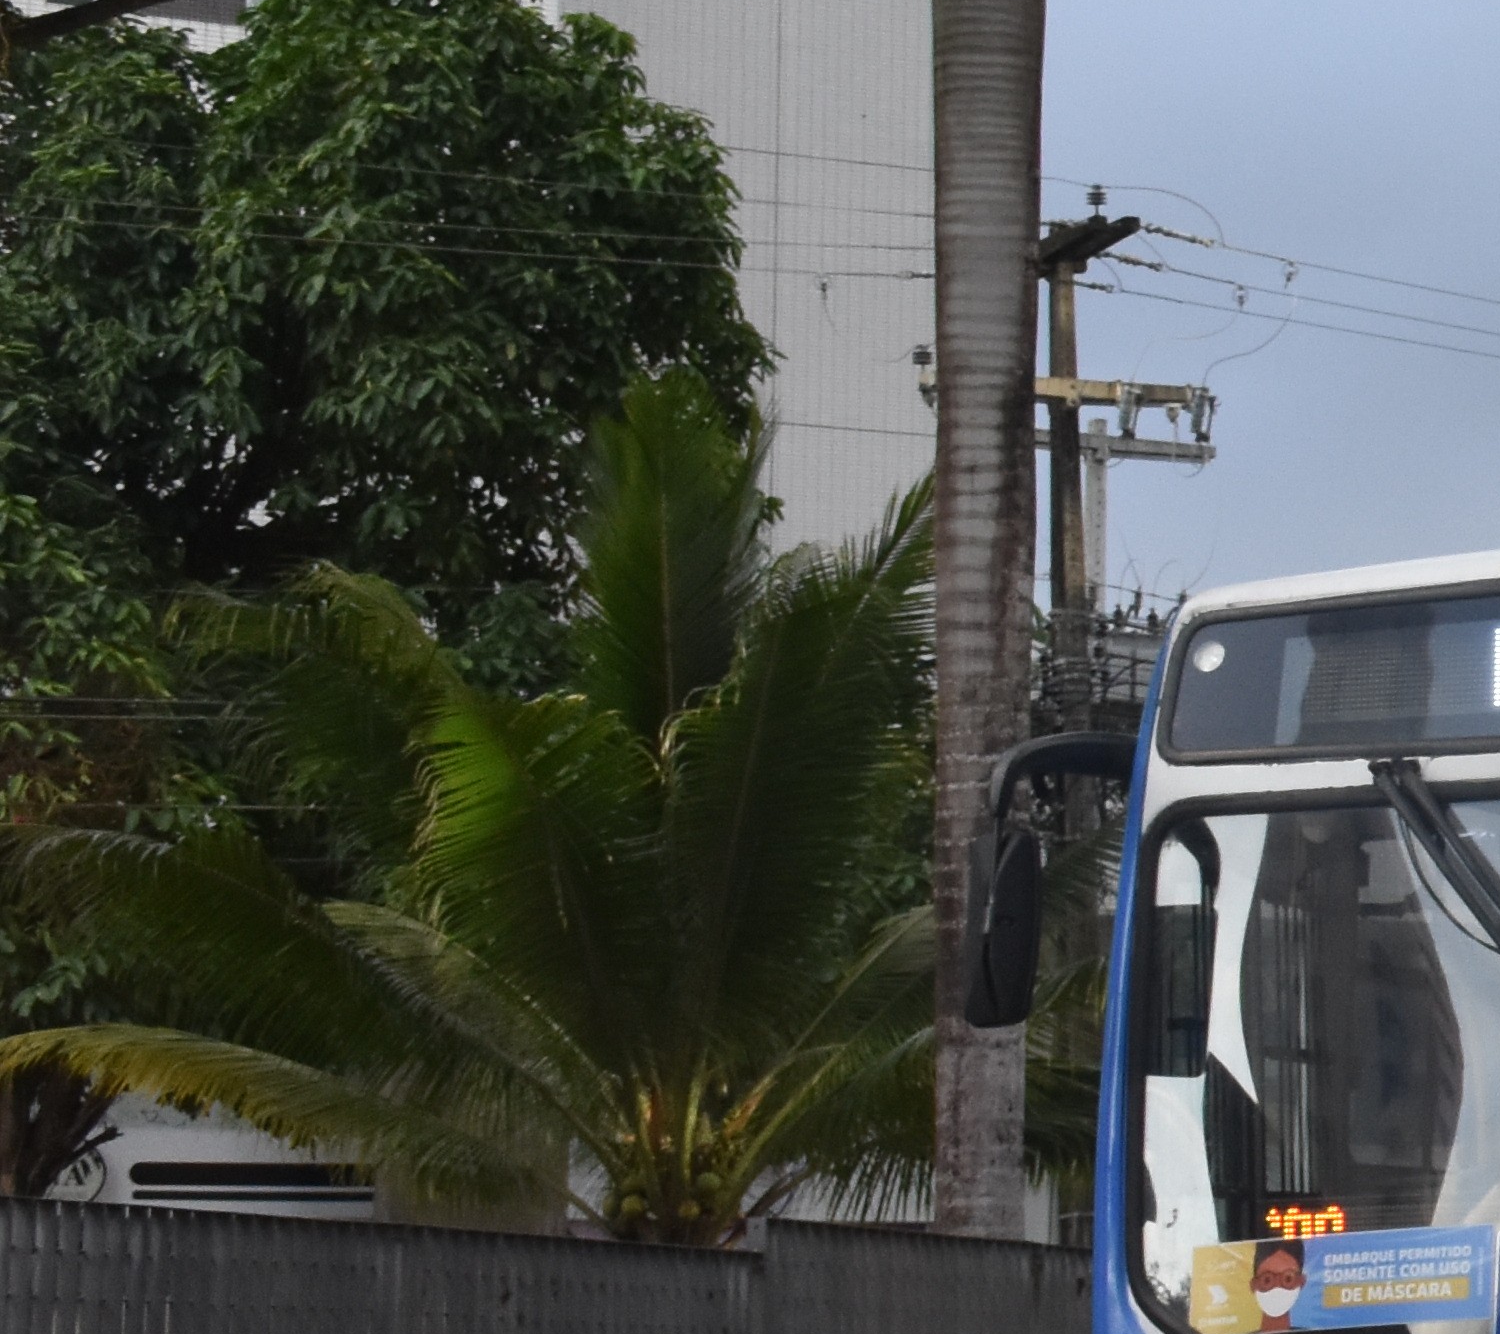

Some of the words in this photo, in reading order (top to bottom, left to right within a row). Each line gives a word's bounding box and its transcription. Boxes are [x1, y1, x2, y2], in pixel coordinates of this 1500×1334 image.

[1323, 1249, 1396, 1267] EMBARQUE
[1399, 1245, 1472, 1261] PERMITIDO
[1323, 1264, 1396, 1284] SOMENTE
[1399, 1261, 1435, 1278] COM
[1438, 1260, 1472, 1276] USO
[1340, 1286, 1363, 1304] DE
[1367, 1280, 1453, 1302] MÁSCARA
